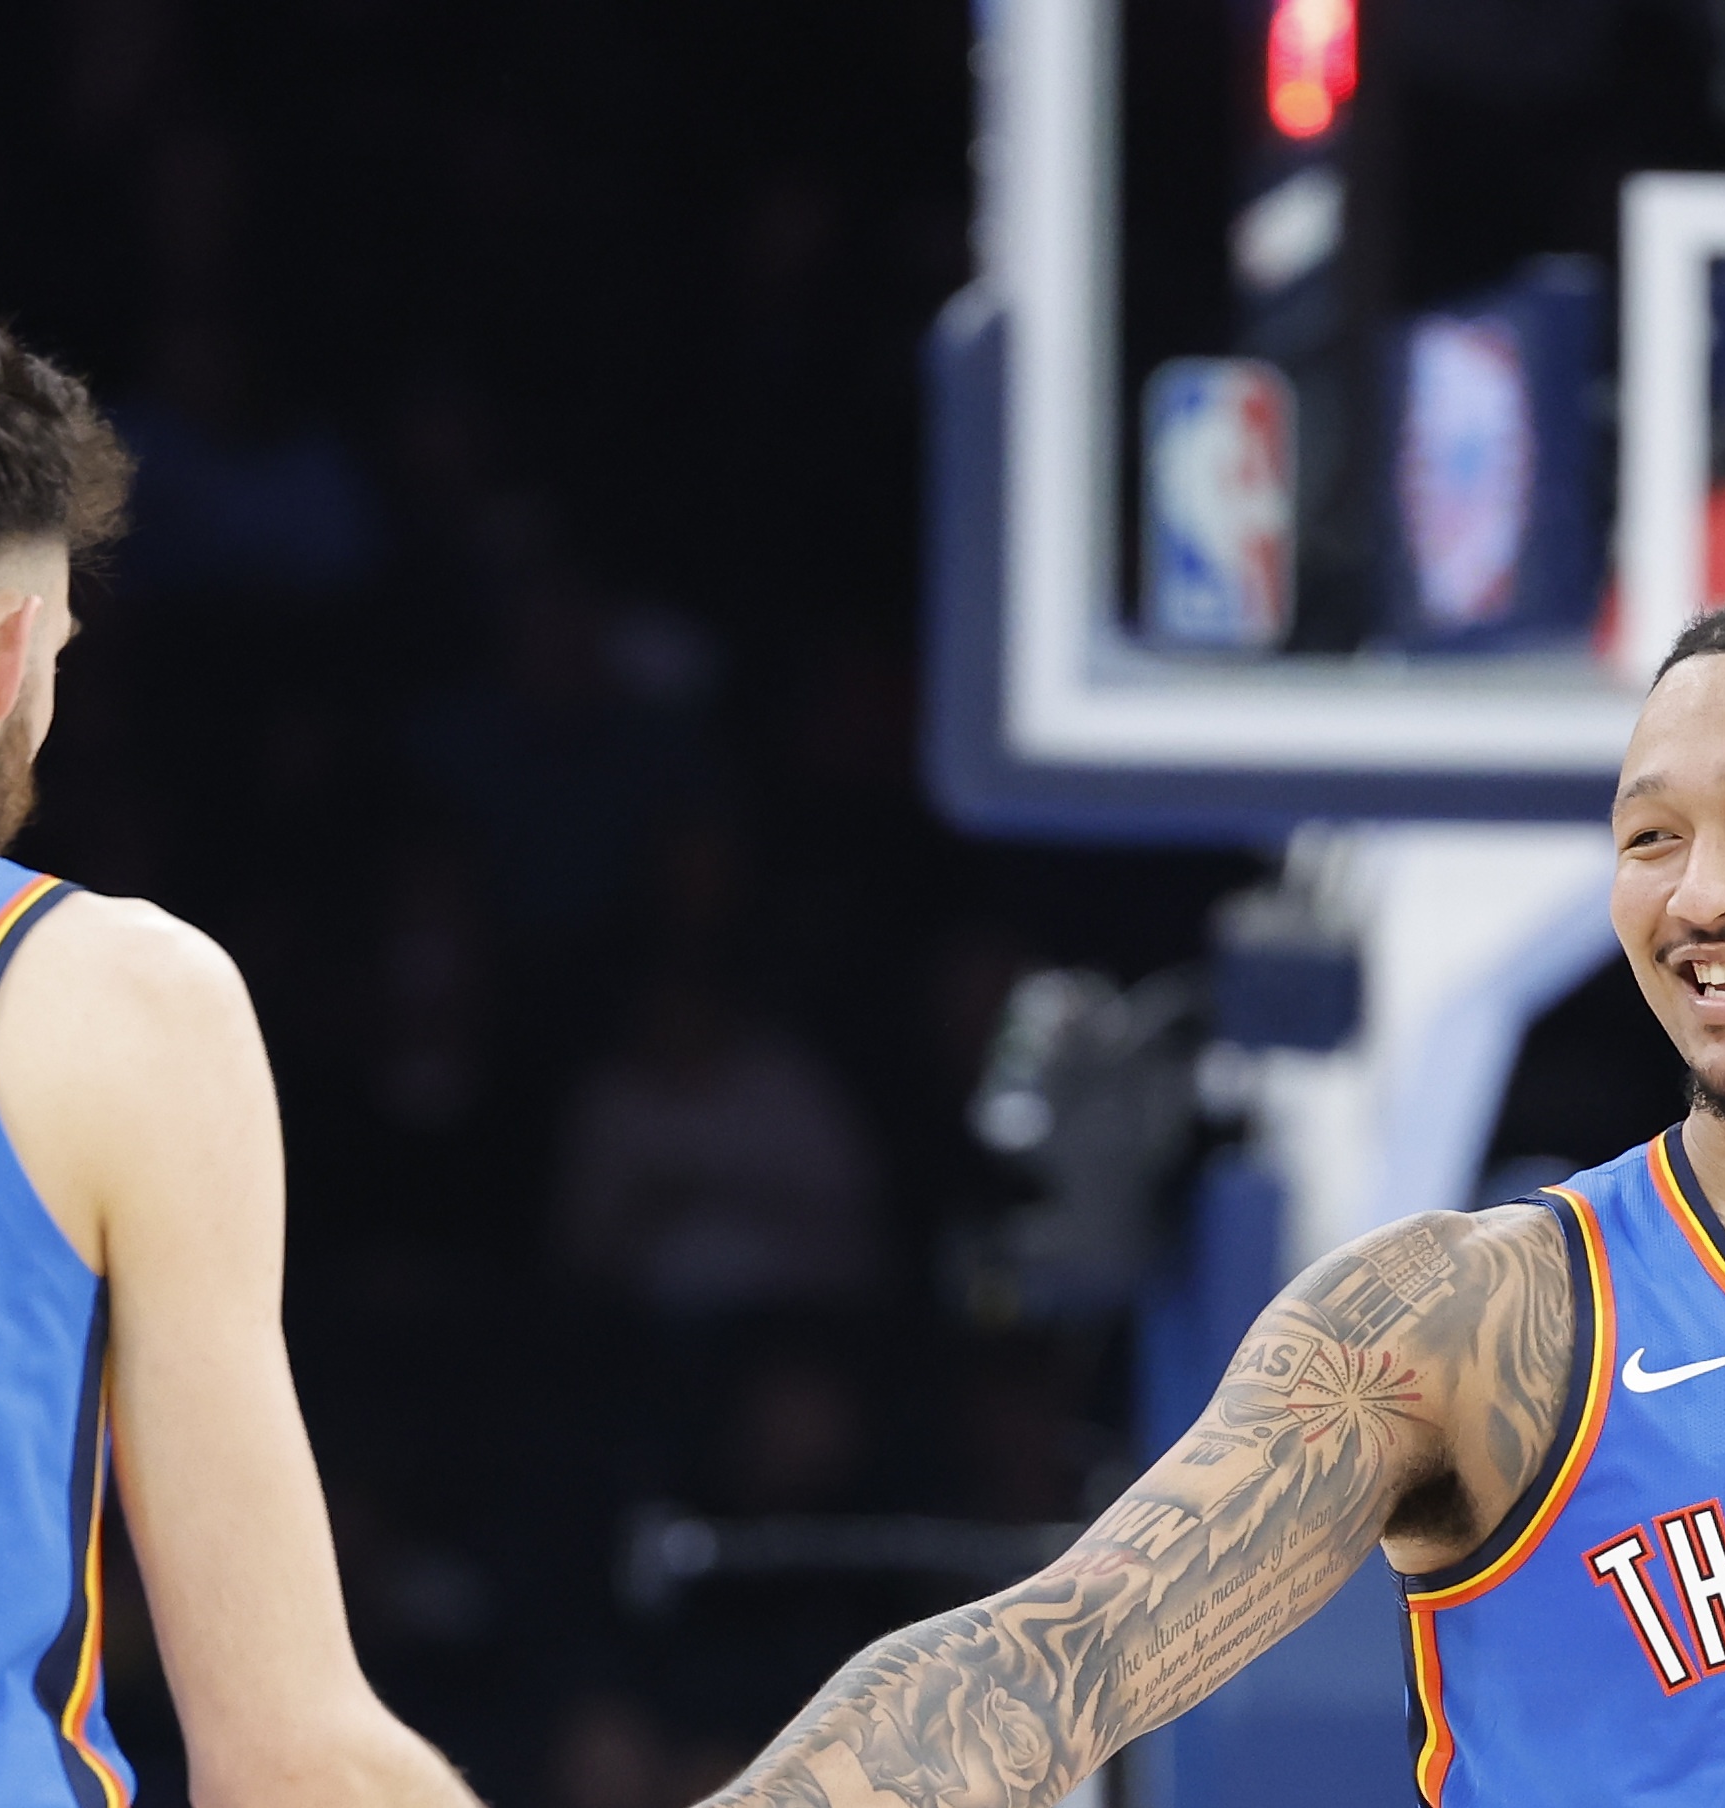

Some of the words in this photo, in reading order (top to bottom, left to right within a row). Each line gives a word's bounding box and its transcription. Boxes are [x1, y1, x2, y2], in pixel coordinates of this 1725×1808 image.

[1145, 1600, 1208, 1662] ultimate
[1211, 1554, 1266, 1609] measure
[1271, 1527, 1287, 1572] of
[1289, 1530, 1297, 1549] a
[1302, 1505, 1332, 1540] man
[1288, 1573, 1311, 1605] but
[1145, 1657, 1188, 1696] where
[1191, 1628, 1209, 1657] he
[1211, 1585, 1257, 1641] stands
